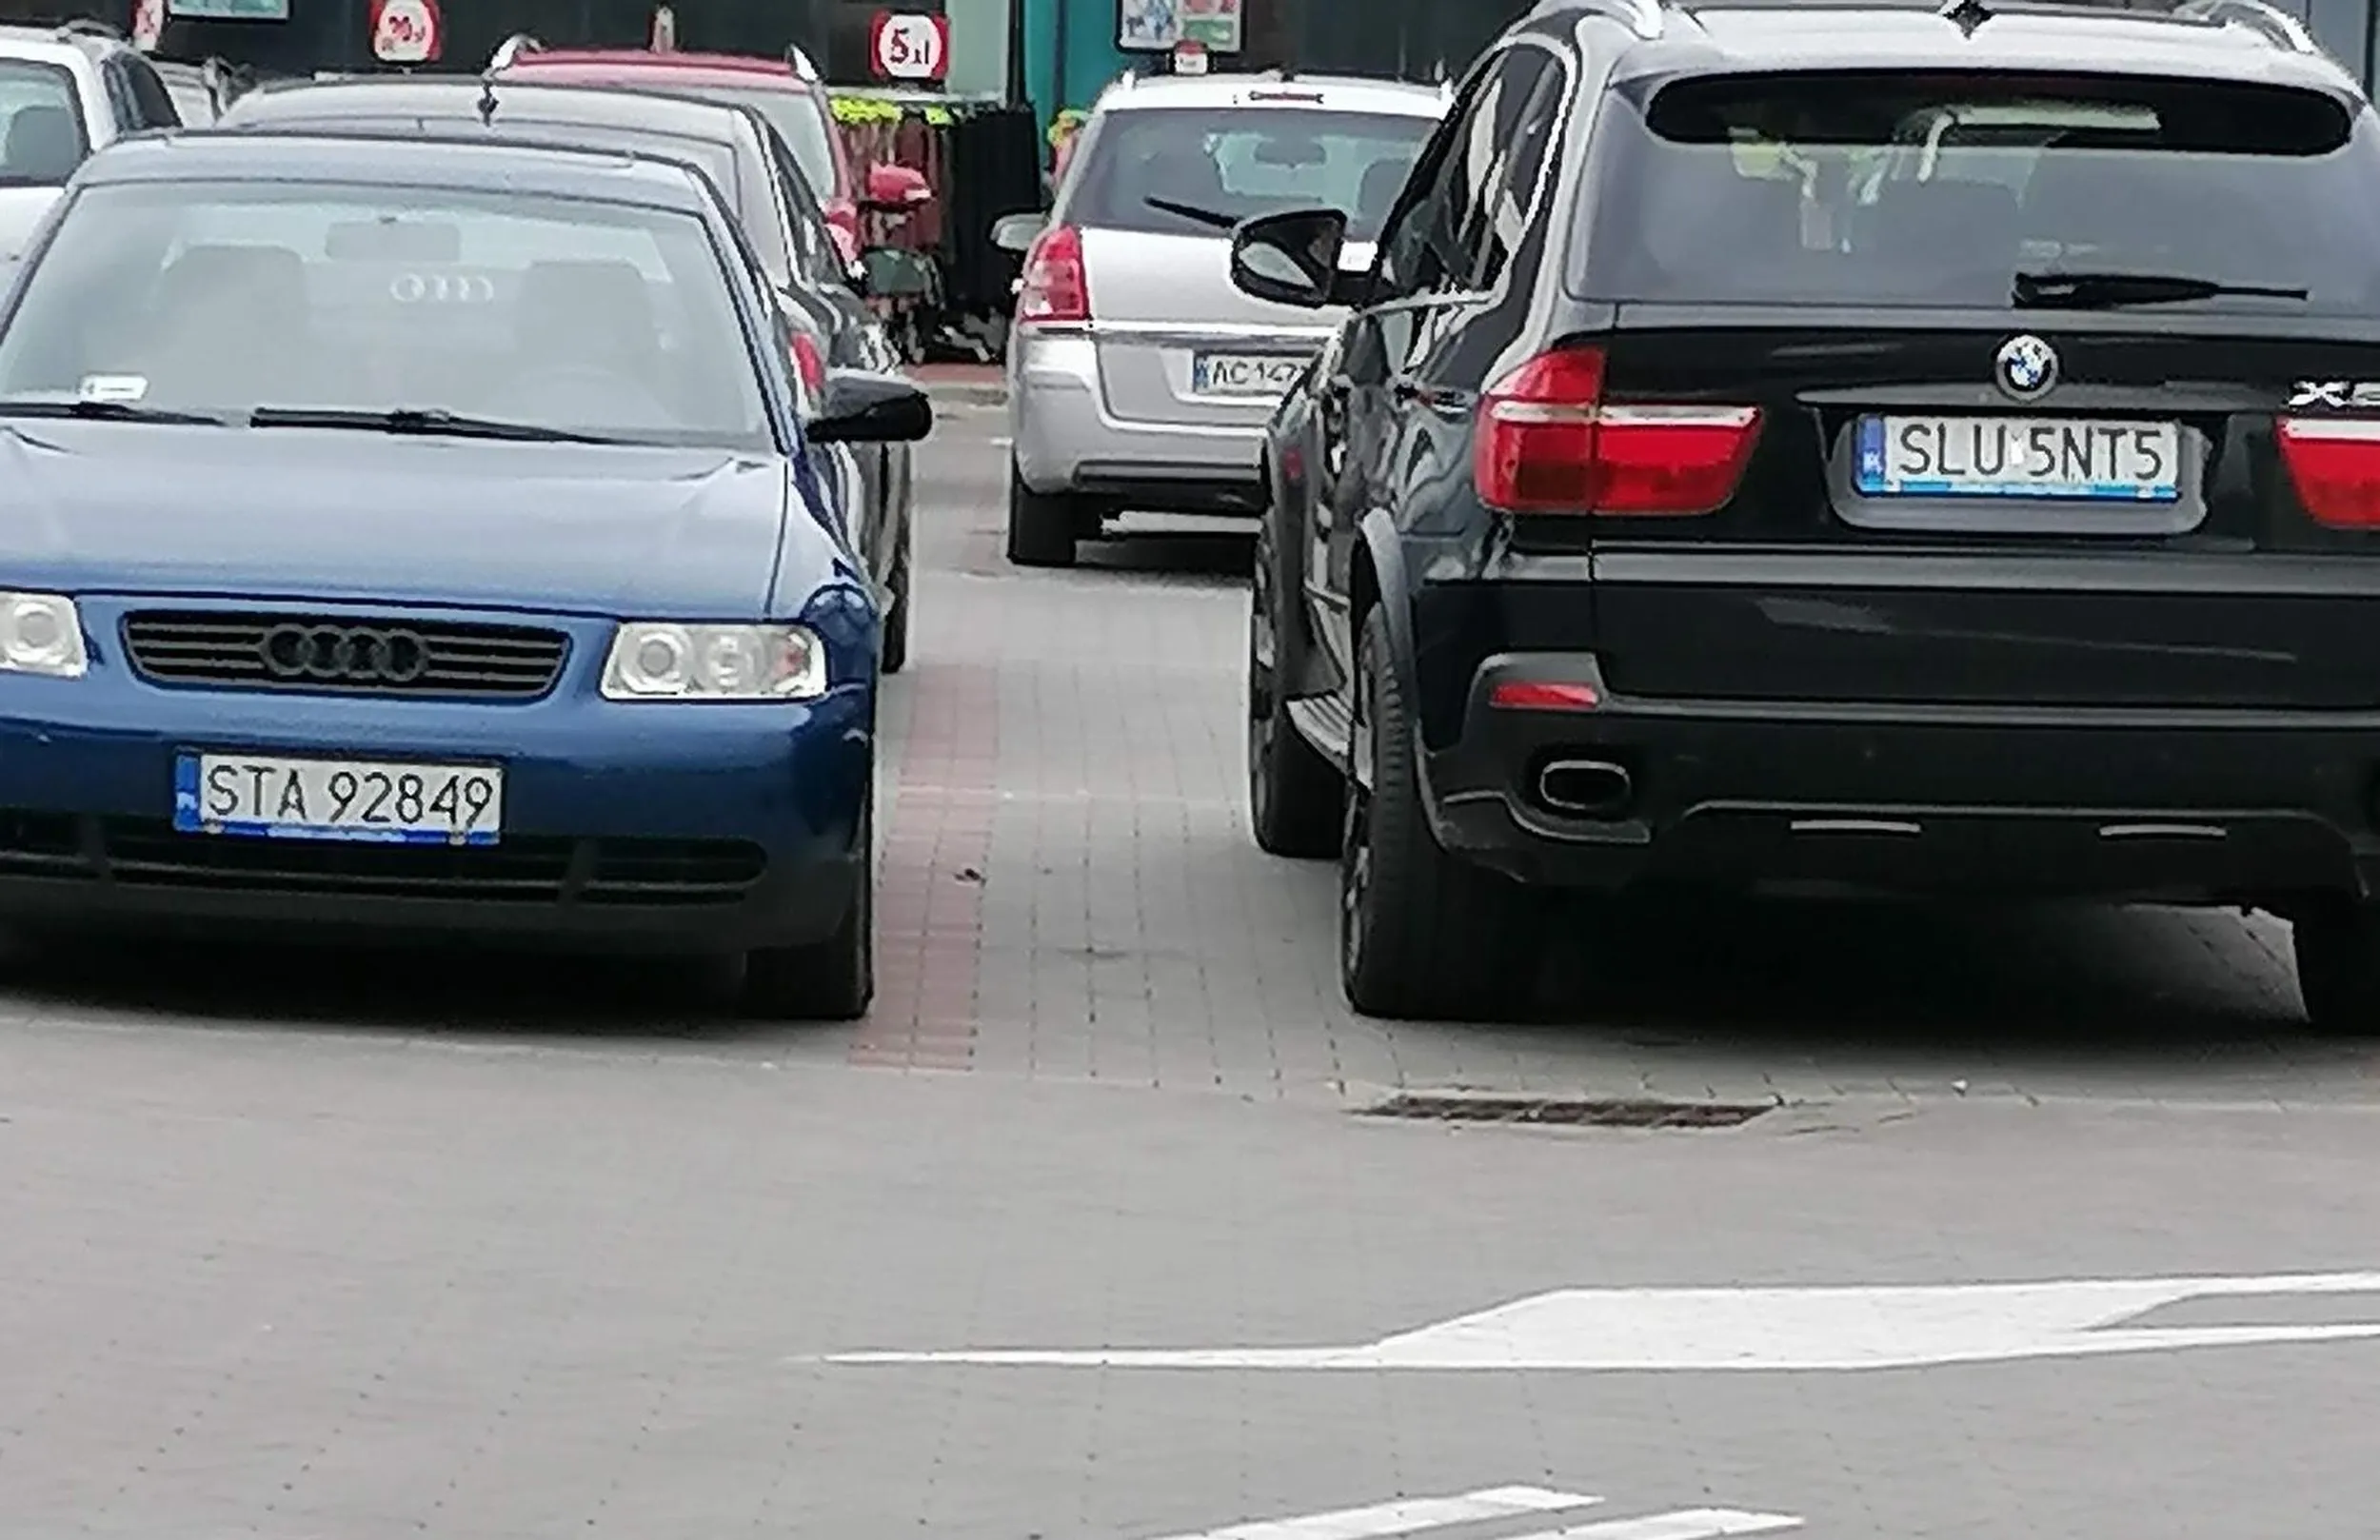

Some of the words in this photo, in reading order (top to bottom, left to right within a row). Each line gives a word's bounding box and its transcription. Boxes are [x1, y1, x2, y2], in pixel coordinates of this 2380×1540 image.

[890, 28, 909, 65] 5
[1899, 423, 2007, 476] SLU
[2028, 427, 2163, 480] 5NT5
[207, 764, 307, 820] STA
[328, 770, 493, 830] 92849
